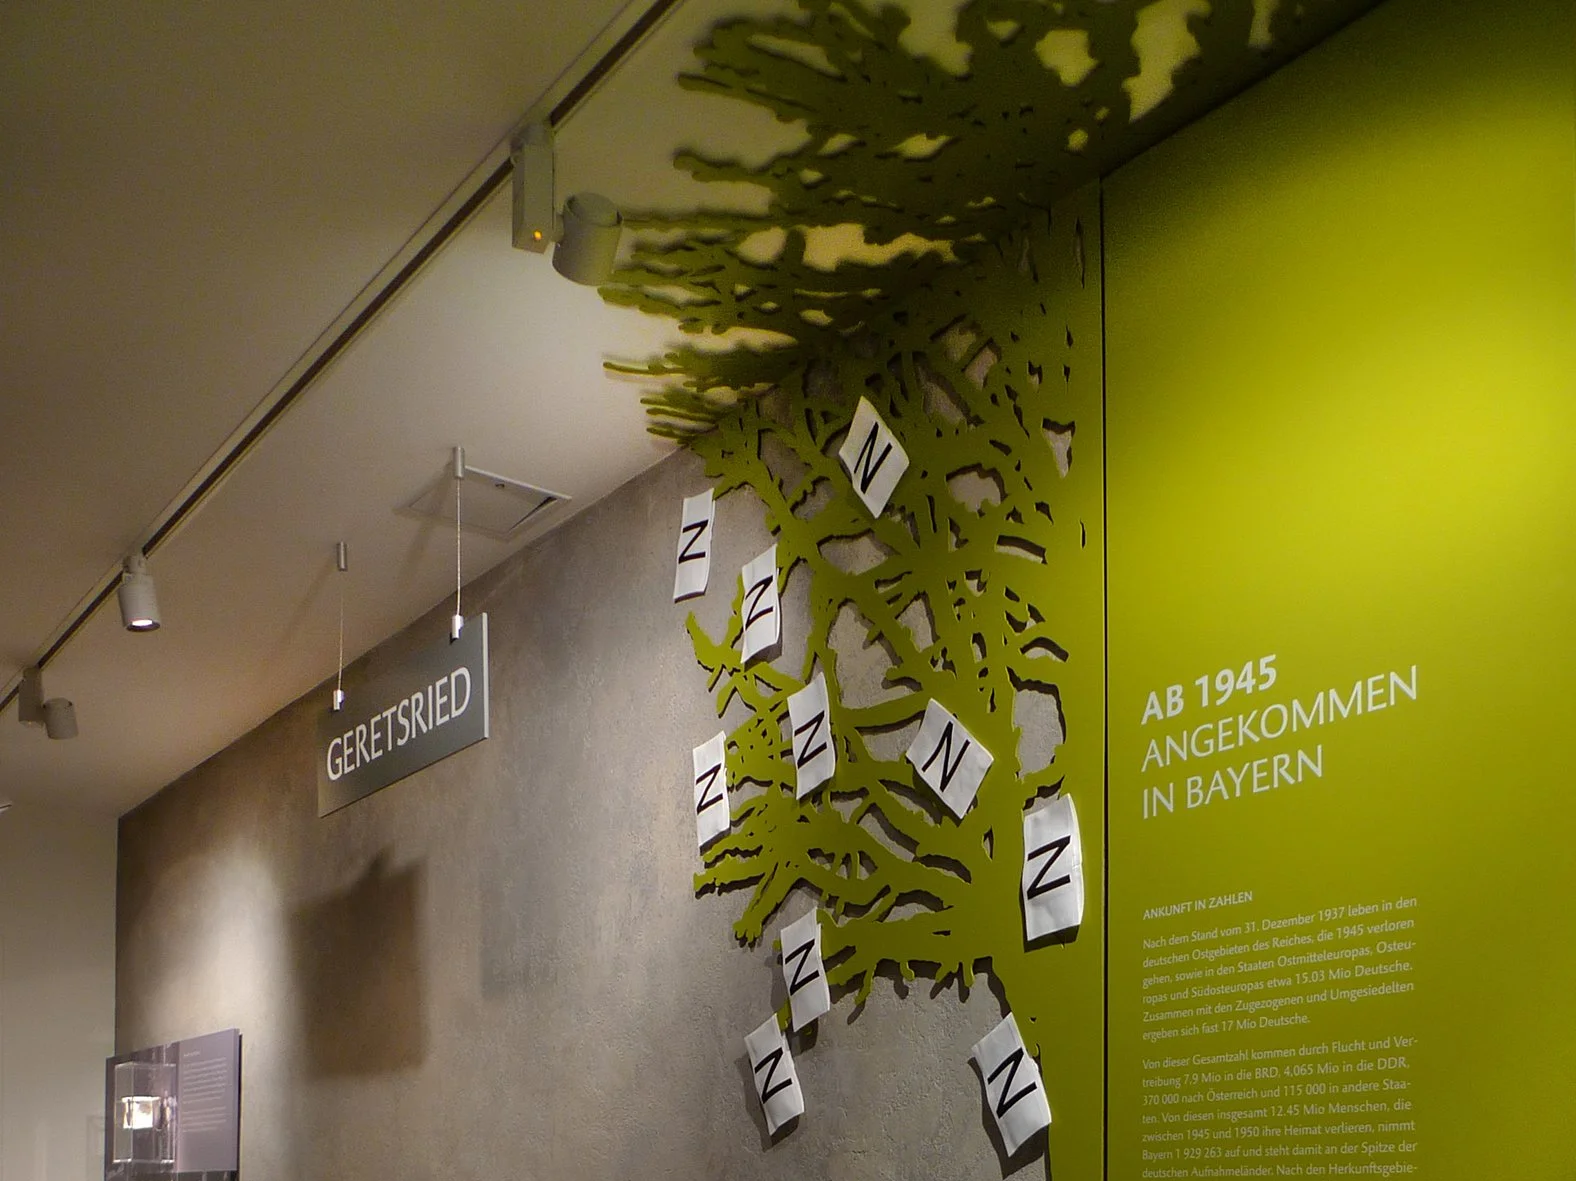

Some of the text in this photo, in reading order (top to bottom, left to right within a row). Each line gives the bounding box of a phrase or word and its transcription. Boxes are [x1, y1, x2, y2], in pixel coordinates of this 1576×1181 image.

[1141, 654, 1277, 725] AB 1945
[327, 667, 471, 781] GERETSRIED
[1141, 665, 1417, 773] ANGEKOMMEN
[1144, 744, 1323, 820] IN BAYERN
[1142, 891, 1252, 920] ANKUNFT IN ZAHLEN
[1142, 936, 1166, 949] Nach
[1168, 934, 1189, 945] dem
[1190, 927, 1218, 942] Stand
[1219, 926, 1241, 937] vom
[1261, 914, 1314, 931] Dezember
[1318, 906, 1344, 921] 1937
[1347, 904, 1378, 916] leben
[1381, 902, 1392, 911] in
[1394, 897, 1416, 909] den
[1142, 953, 1189, 968] deutschen
[1191, 944, 1249, 962] Ostgebieten
[1251, 940, 1270, 951] des
[1316, 930, 1333, 942] die
[1337, 924, 1364, 938] 1945
[1366, 919, 1414, 934] verloren
[1142, 993, 1167, 1005] ropas
[1169, 987, 1189, 1001] und
[1191, 981, 1264, 998] Südosteuropas
[1266, 977, 1292, 988] etwa
[1328, 967, 1351, 980] Mio
[1174, 970, 1203, 982] sowie
[1204, 968, 1214, 977] in
[1216, 965, 1235, 976] den
[1237, 960, 1275, 973] Staaten
[1143, 981, 1414, 1022] Zusammen mit den Zugezogenen und Umgesiedelten
[1142, 1028, 1178, 1042] ergeben
[1180, 1024, 1199, 1036] sich
[1201, 1022, 1219, 1034] fast
[1221, 1019, 1233, 1032] 17
[1236, 1018, 1257, 1029] Mio
[1142, 1059, 1160, 1070] Von
[1162, 1057, 1190, 1068] dieser
[1192, 1049, 1248, 1065] Gesamtzahl
[1250, 1048, 1296, 1060] kommen
[1298, 1042, 1328, 1056] durch
[1331, 1040, 1366, 1053] Flucht
[1368, 1036, 1390, 1050] und
[1142, 1077, 1181, 1089] treibung
[1201, 1072, 1221, 1083] Mio
[1224, 1073, 1233, 1081] in
[1235, 1069, 1252, 1081] die
[1316, 1062, 1339, 1074] Mio
[1342, 1063, 1353, 1072] in
[1356, 1059, 1374, 1072] die
[1161, 1093, 1179, 1105] 000
[1181, 1091, 1204, 1103] nach
[1206, 1087, 1258, 1102] Österreich
[1260, 1085, 1280, 1098] und
[1283, 1084, 1302, 1096] 115
[1305, 1083, 1326, 1095] 000
[1328, 1085, 1339, 1093] in
[1341, 1080, 1379, 1093] andere
[1161, 1112, 1180, 1123] Von
[1182, 1112, 1214, 1122] diesen
[1216, 1107, 1267, 1123] insgesamt
[1303, 1103, 1325, 1115] Mio
[1393, 1098, 1412, 1111] die
[1142, 1132, 1183, 1142] zwischen
[1187, 1128, 1209, 1140] 1945
[1212, 1127, 1232, 1139] und
[1234, 1126, 1260, 1138] 1950
[1261, 1126, 1281, 1136] ihre
[1284, 1125, 1322, 1136] Heimat
[1377, 1121, 1415, 1132] nimmt
[1142, 1149, 1172, 1163] Bayern
[1183, 1147, 1201, 1160] 929
[1204, 1146, 1222, 1158] 263
[1224, 1145, 1240, 1158] auf
[1242, 1145, 1262, 1157] und
[1264, 1144, 1290, 1156] steht
[1291, 1143, 1322, 1156] damit
[1324, 1145, 1338, 1154] an
[1339, 1142, 1358, 1154] der
[1361, 1141, 1395, 1156] Spitze
[1398, 1140, 1417, 1152] der
[1142, 1167, 1188, 1178] deutschen
[1276, 1164, 1302, 1176] Nach
[1305, 1163, 1325, 1175] den
